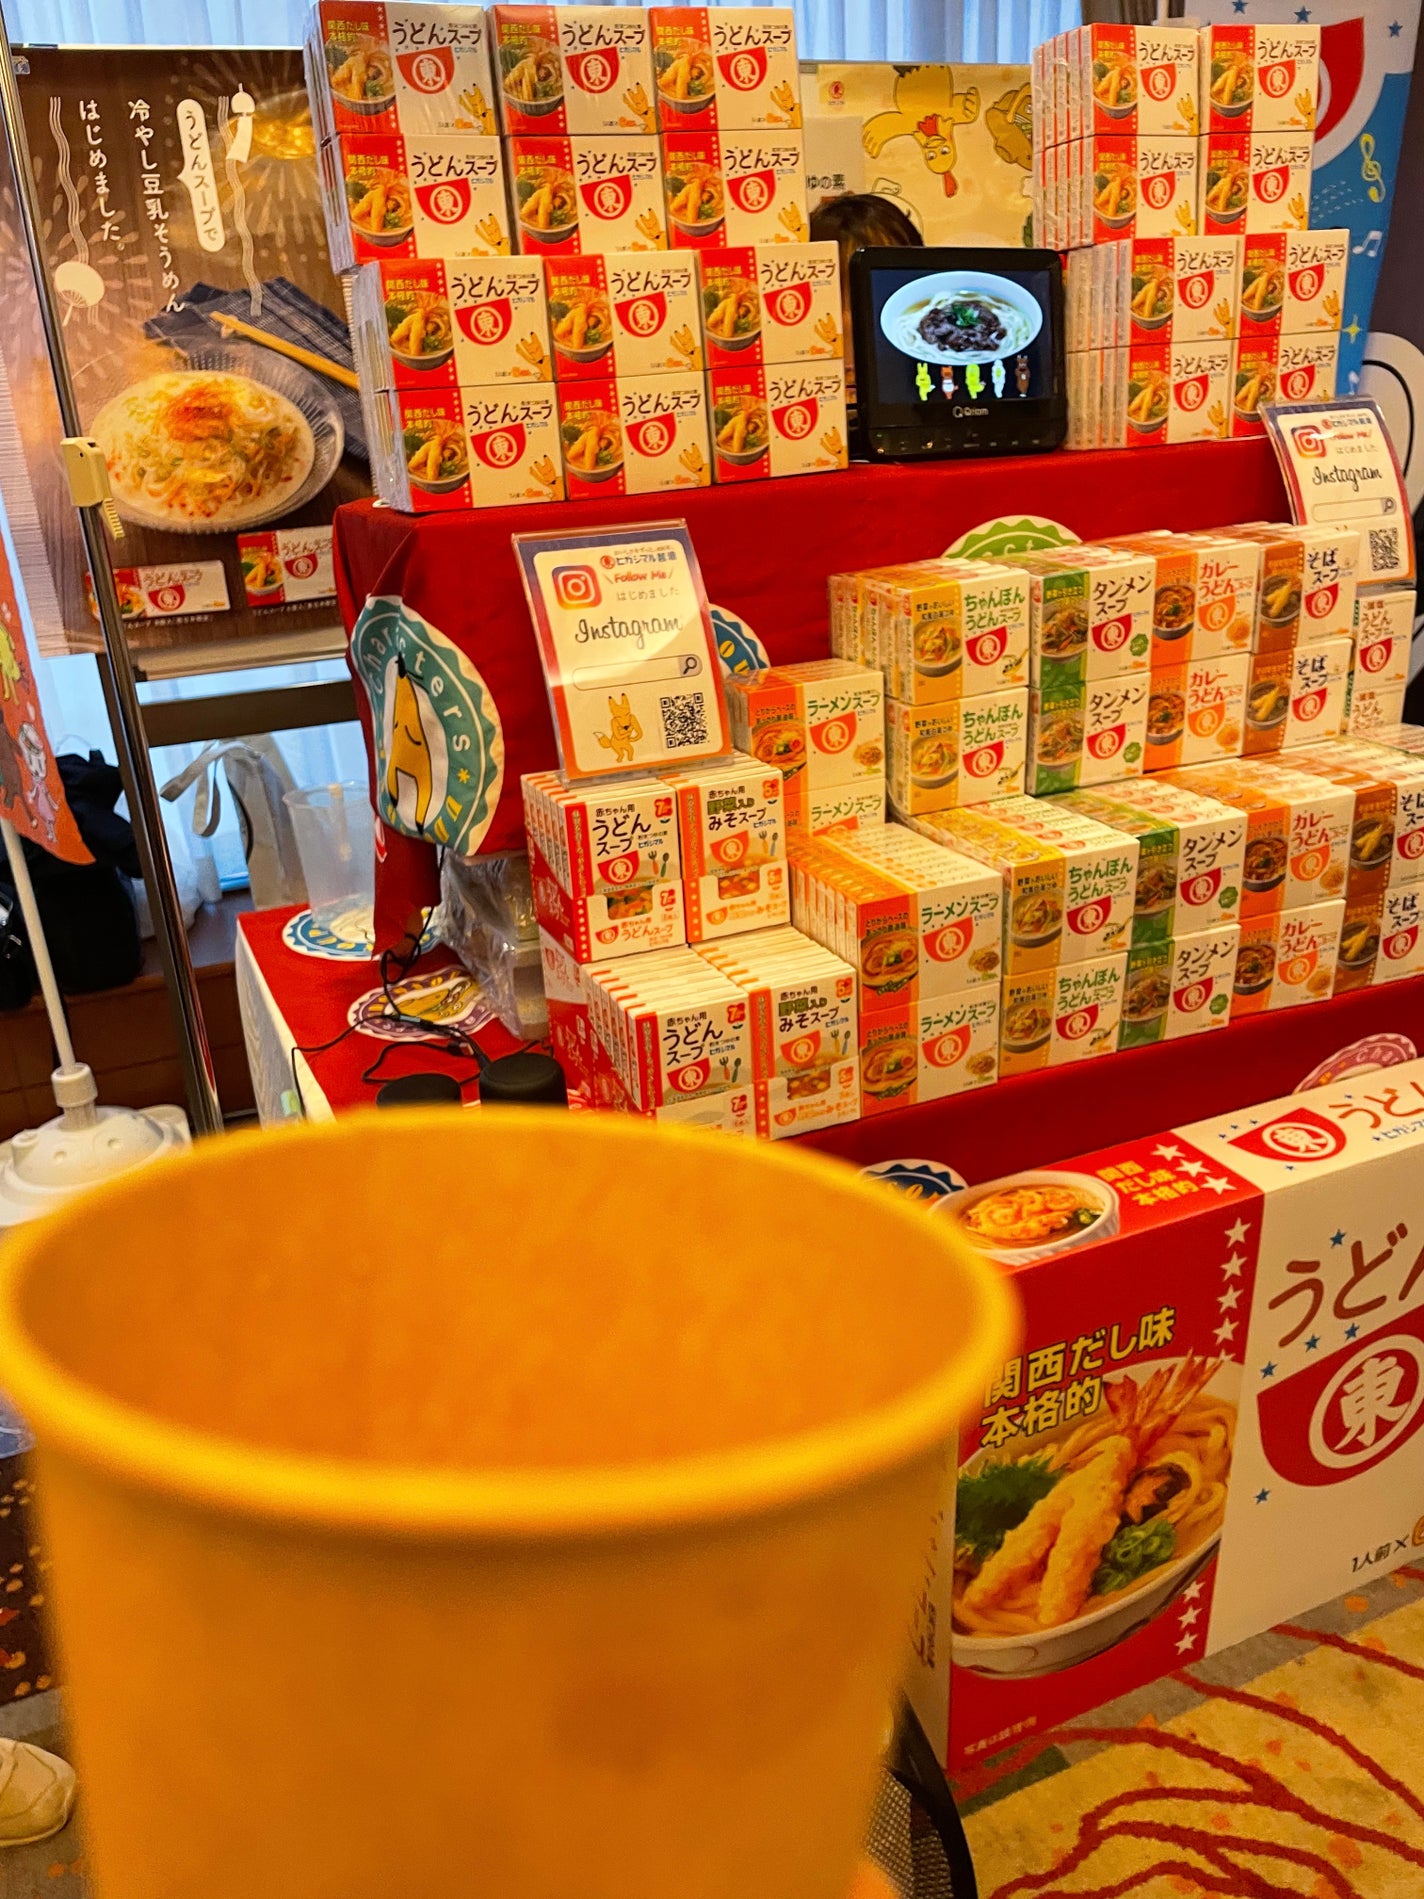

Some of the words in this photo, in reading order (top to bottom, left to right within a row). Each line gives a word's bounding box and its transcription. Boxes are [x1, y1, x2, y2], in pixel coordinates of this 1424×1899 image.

[392, 19, 482, 45] うどんスープ
[562, 22, 645, 46] うどんスープ
[714, 23, 792, 46] うどんスープ
[411, 153, 498, 177] うどんスープ
[577, 151, 657, 175] うどんスープ
[724, 146, 800, 171] うどんスープ
[183, 110, 220, 242] うどんスープで
[127, 98, 186, 313] 冷やし豆乳そうめん
[611, 269, 692, 294] うどんスープ
[761, 259, 836, 283] うどんスープ
[450, 273, 540, 298] うどんスープ
[769, 376, 842, 401] うどんスープ
[467, 401, 552, 427] うどんスープ
[622, 391, 701, 416] うどんスープ
[1312, 465, 1383, 492] Instagram
[1307, 546, 1338, 569] そば
[1199, 562, 1240, 580] カレー
[1312, 566, 1340, 585] スープ
[1093, 575, 1152, 601] タンメン
[1095, 597, 1128, 616] スープ
[575, 615, 680, 650] Instagram
[1296, 655, 1328, 674] そば
[1189, 669, 1229, 687] カレー
[1300, 673, 1329, 691] スープ
[807, 694, 881, 717] ラーメンスープ
[1090, 687, 1147, 712] タンメン
[1091, 708, 1124, 727] スープ
[708, 786, 746, 799] 赤ちゃん用
[596, 803, 635, 817] 赤ちゃん用
[708, 807, 767, 831] みそスープ
[811, 797, 883, 823] ラーメンスープ
[1292, 812, 1334, 832] カレー
[592, 813, 651, 841] うどん
[597, 836, 634, 856] スープ
[1183, 829, 1243, 858] タンメン
[1184, 851, 1219, 872] スープ
[921, 897, 999, 925] ラーメンスープ
[1387, 895, 1418, 914] そば
[621, 924, 673, 941] うどんスープ
[1281, 919, 1324, 938] カレー
[1391, 912, 1419, 930] スープ
[1176, 941, 1235, 968] タンメン
[1177, 960, 1212, 981] スープ
[780, 985, 818, 1001] 赤ちゃん用
[667, 1012, 708, 1027] 赤ちゃん用
[779, 1006, 840, 1033] みそスープ
[921, 1004, 997, 1034] ラーメンスープ
[662, 1020, 724, 1051] うどん
[667, 1043, 705, 1066] スープ
[1327, 1081, 1424, 1130] うど
[1272, 1124, 1329, 1154] 東
[1267, 1222, 1424, 1348] うど
[984, 1306, 1177, 1409] 関西だし味
[980, 1376, 1105, 1450] 本格的
[1333, 1355, 1412, 1451] 東
